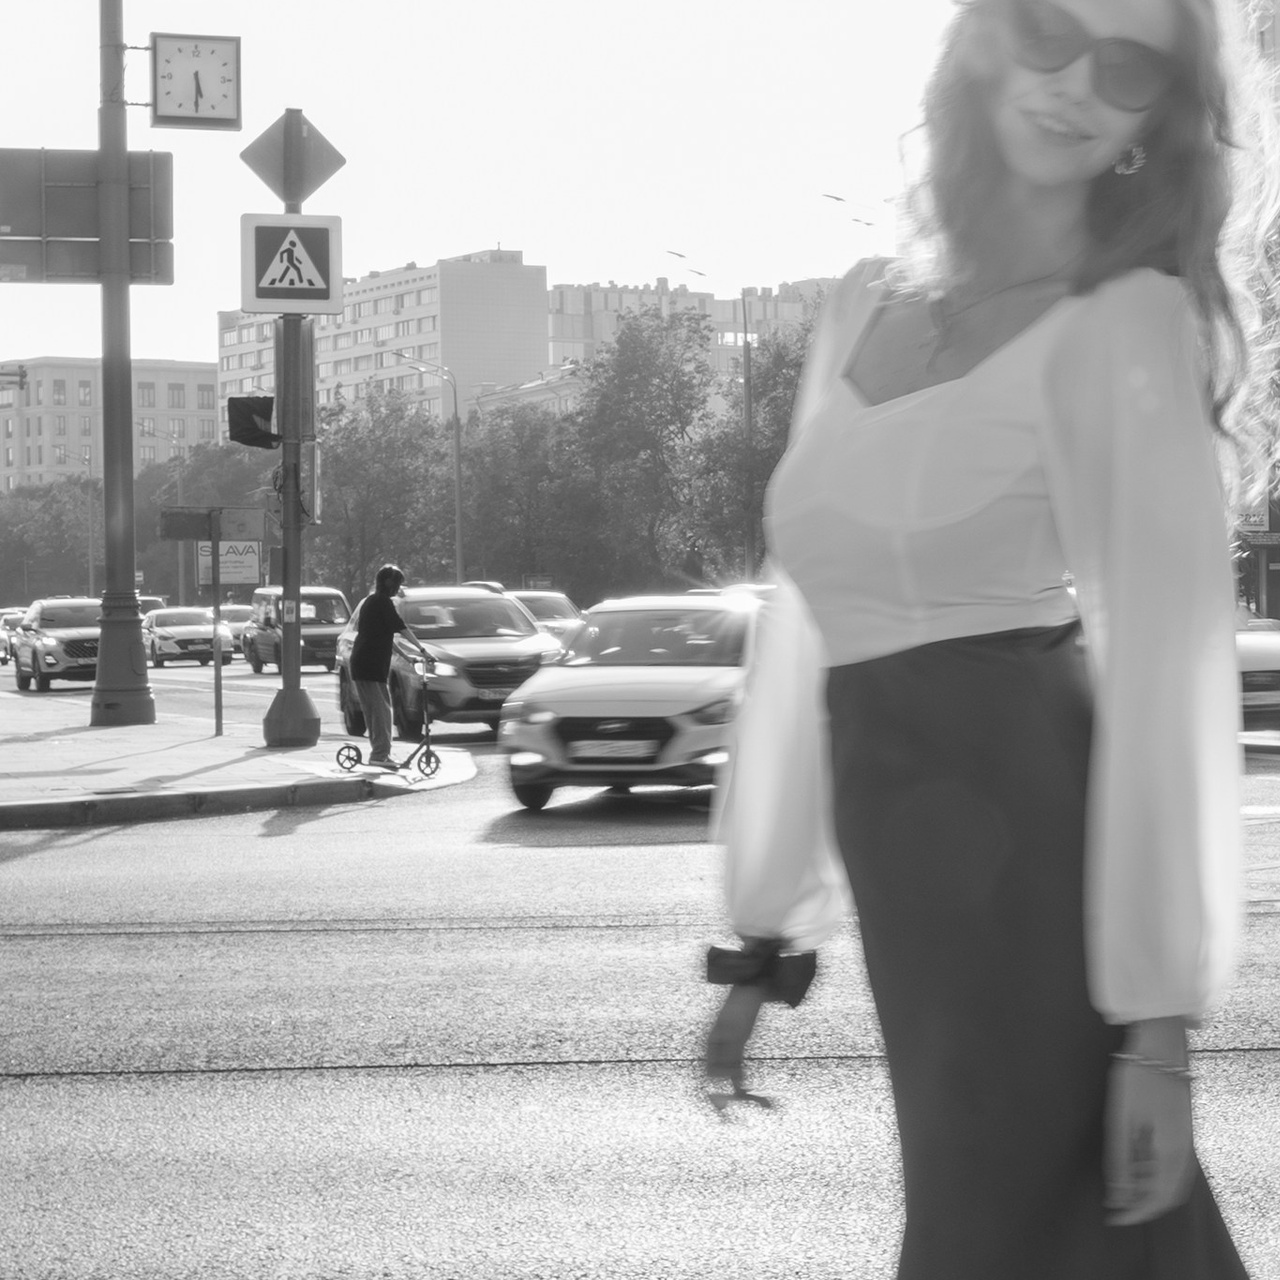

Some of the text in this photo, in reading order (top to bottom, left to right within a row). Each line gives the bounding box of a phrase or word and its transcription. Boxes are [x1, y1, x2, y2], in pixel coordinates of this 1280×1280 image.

[192, 50, 200, 58] 12
[221, 76, 227, 84] 3
[200, 545, 257, 556] SAVA
